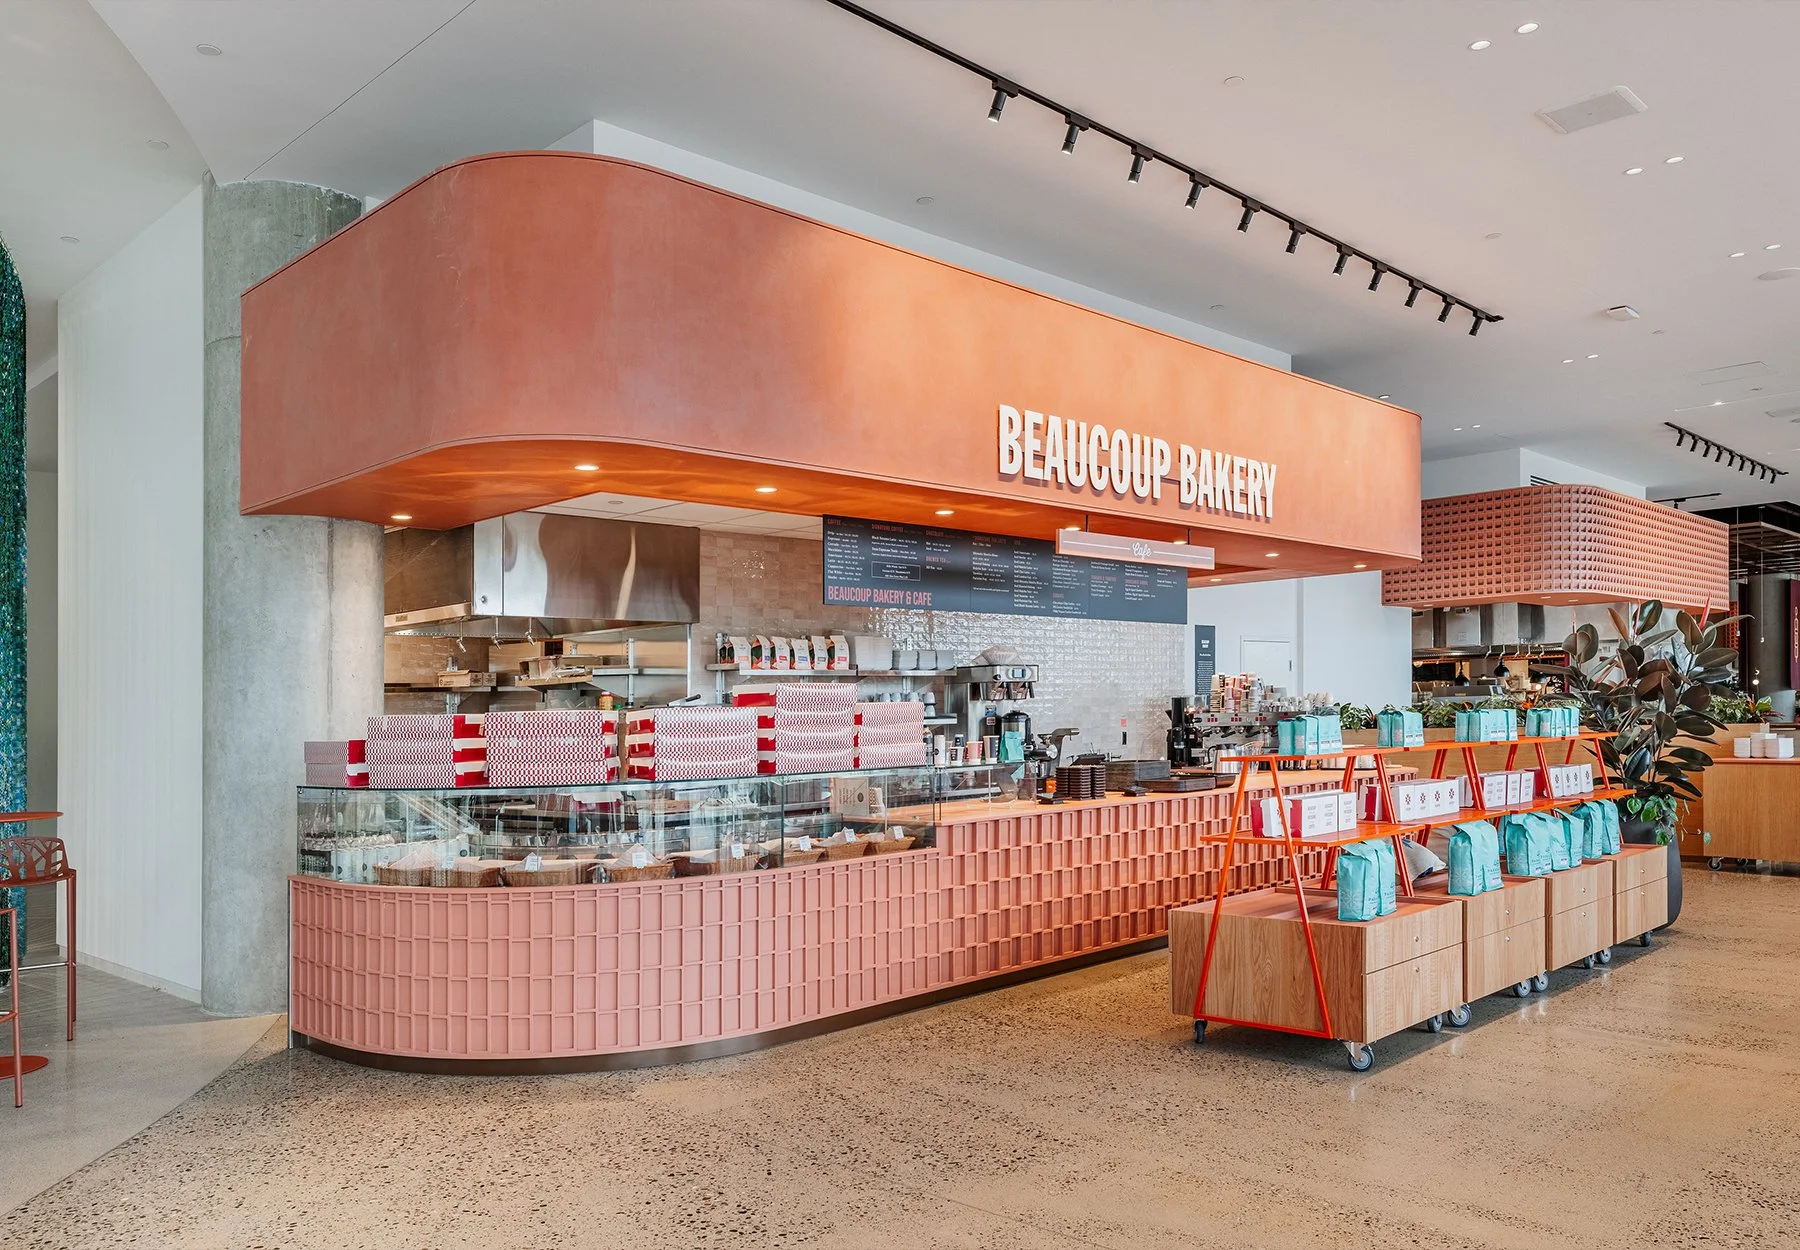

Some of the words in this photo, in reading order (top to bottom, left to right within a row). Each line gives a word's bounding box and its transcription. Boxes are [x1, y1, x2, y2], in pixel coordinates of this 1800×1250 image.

[999, 404, 1171, 499] BEAUCOUP
[1179, 444, 1277, 518] BAKERY
[828, 586, 871, 602] BEAUCOUP
[873, 589, 904, 604] BAKERY
[906, 591, 911, 604] &
[913, 591, 932, 606] CAFE
